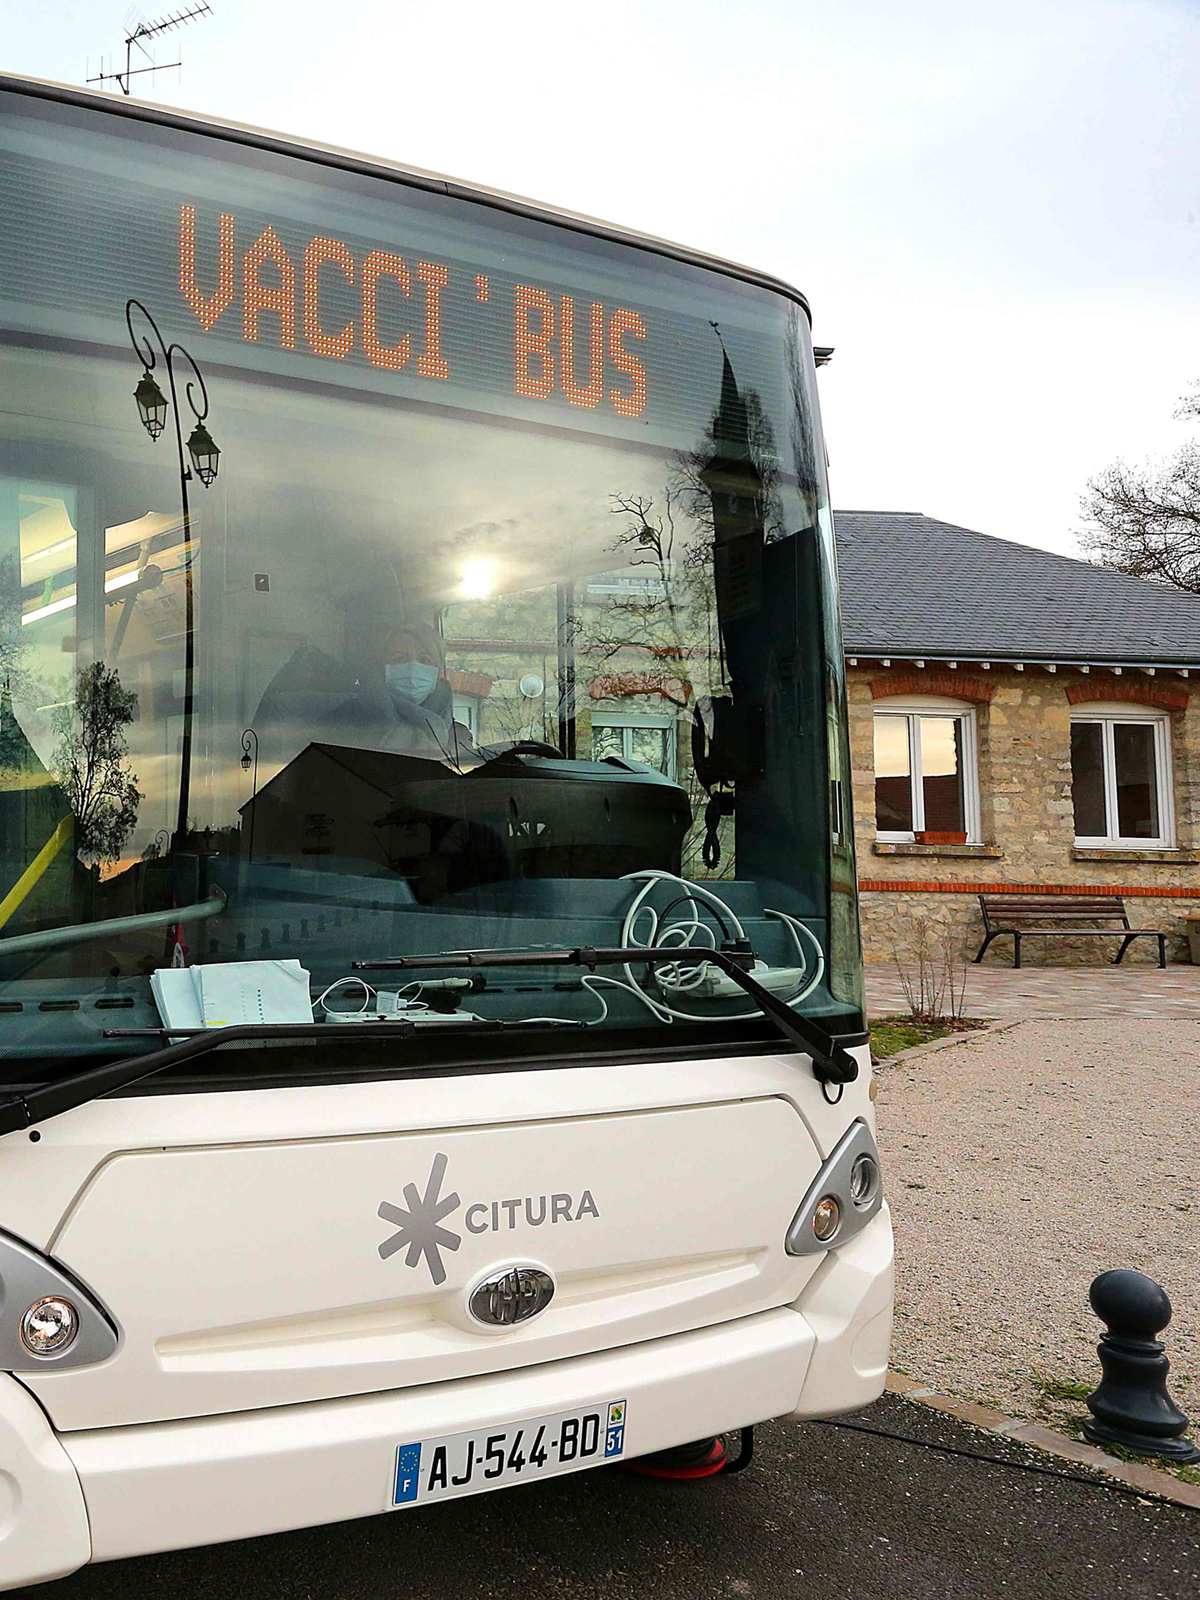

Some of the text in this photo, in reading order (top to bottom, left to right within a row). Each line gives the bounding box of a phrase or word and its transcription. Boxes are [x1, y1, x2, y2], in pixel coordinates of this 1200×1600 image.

[514, 284, 648, 418] BUS
[464, 1189, 601, 1235] CITURA
[426, 1412, 601, 1493] AJ-544-BD
[606, 1428, 624, 1453] 51
[401, 1478, 412, 1494] F
